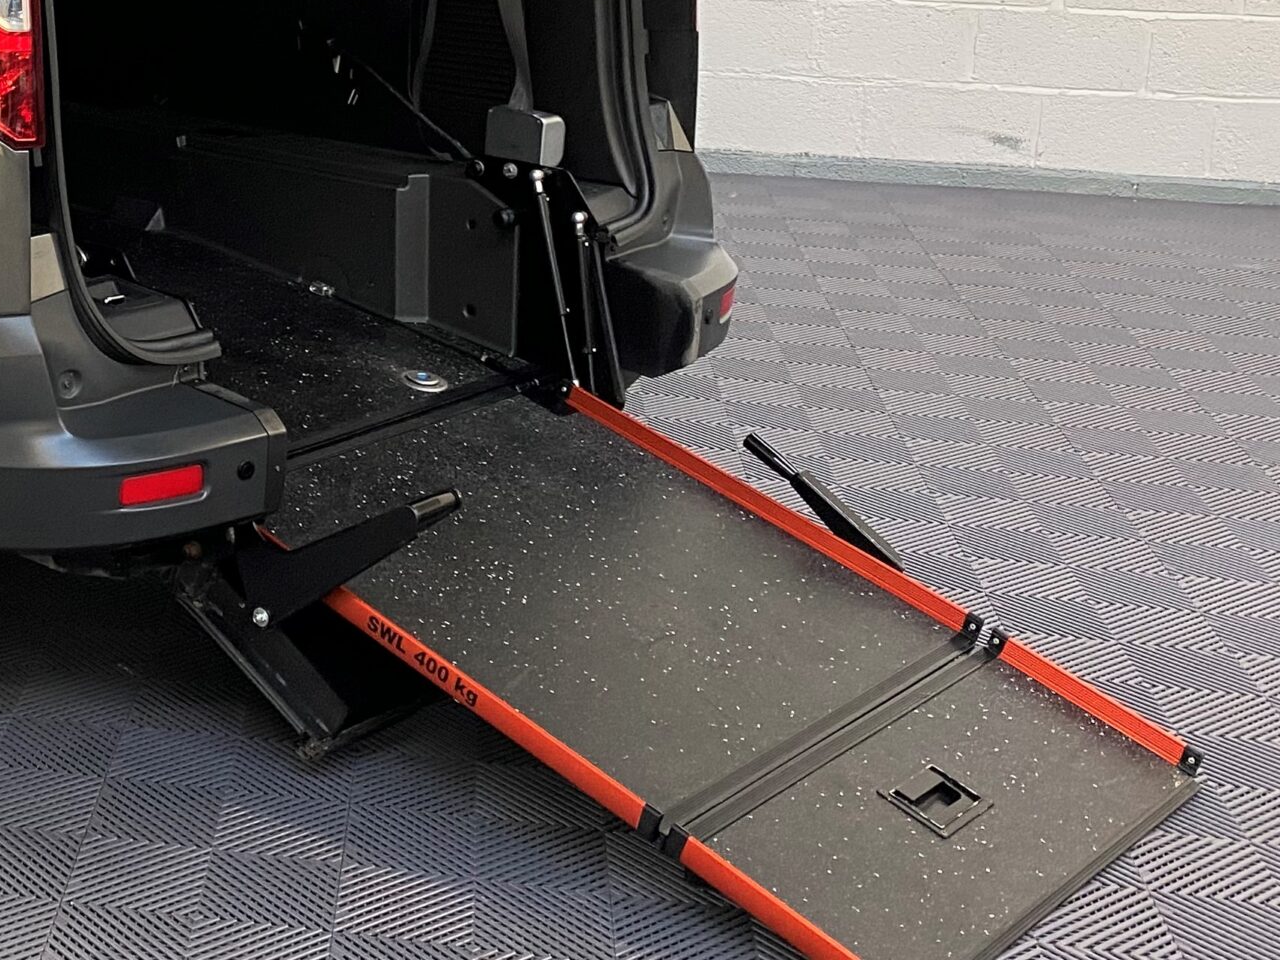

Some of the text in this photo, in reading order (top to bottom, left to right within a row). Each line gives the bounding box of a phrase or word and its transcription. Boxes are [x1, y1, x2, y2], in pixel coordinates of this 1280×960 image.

[366, 615, 479, 707] SWL 400 kg
